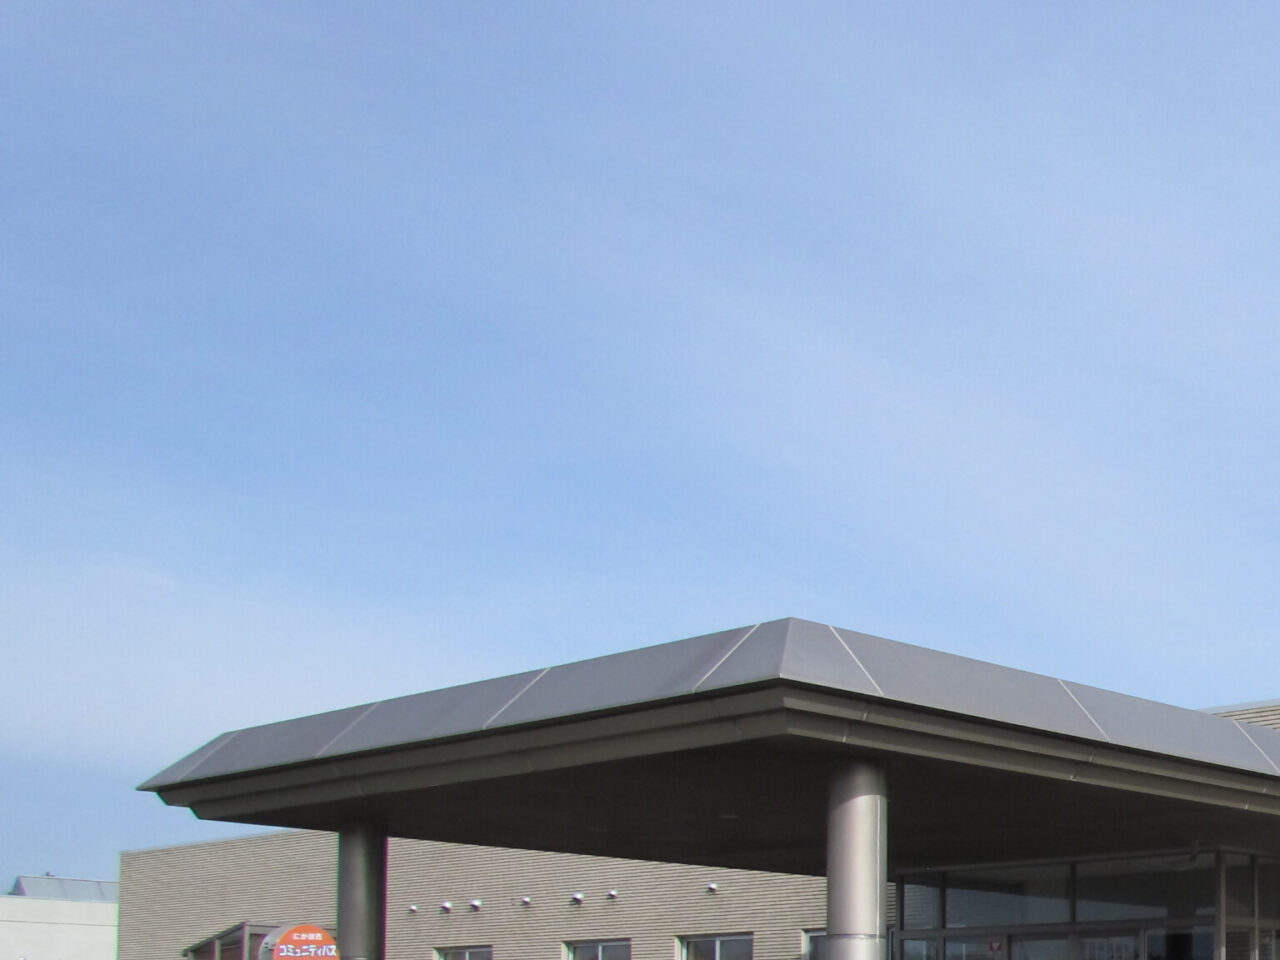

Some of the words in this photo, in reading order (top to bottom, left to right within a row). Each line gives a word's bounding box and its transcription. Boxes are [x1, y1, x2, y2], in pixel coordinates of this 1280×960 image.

[279, 944, 337, 957] コミュニティバス
